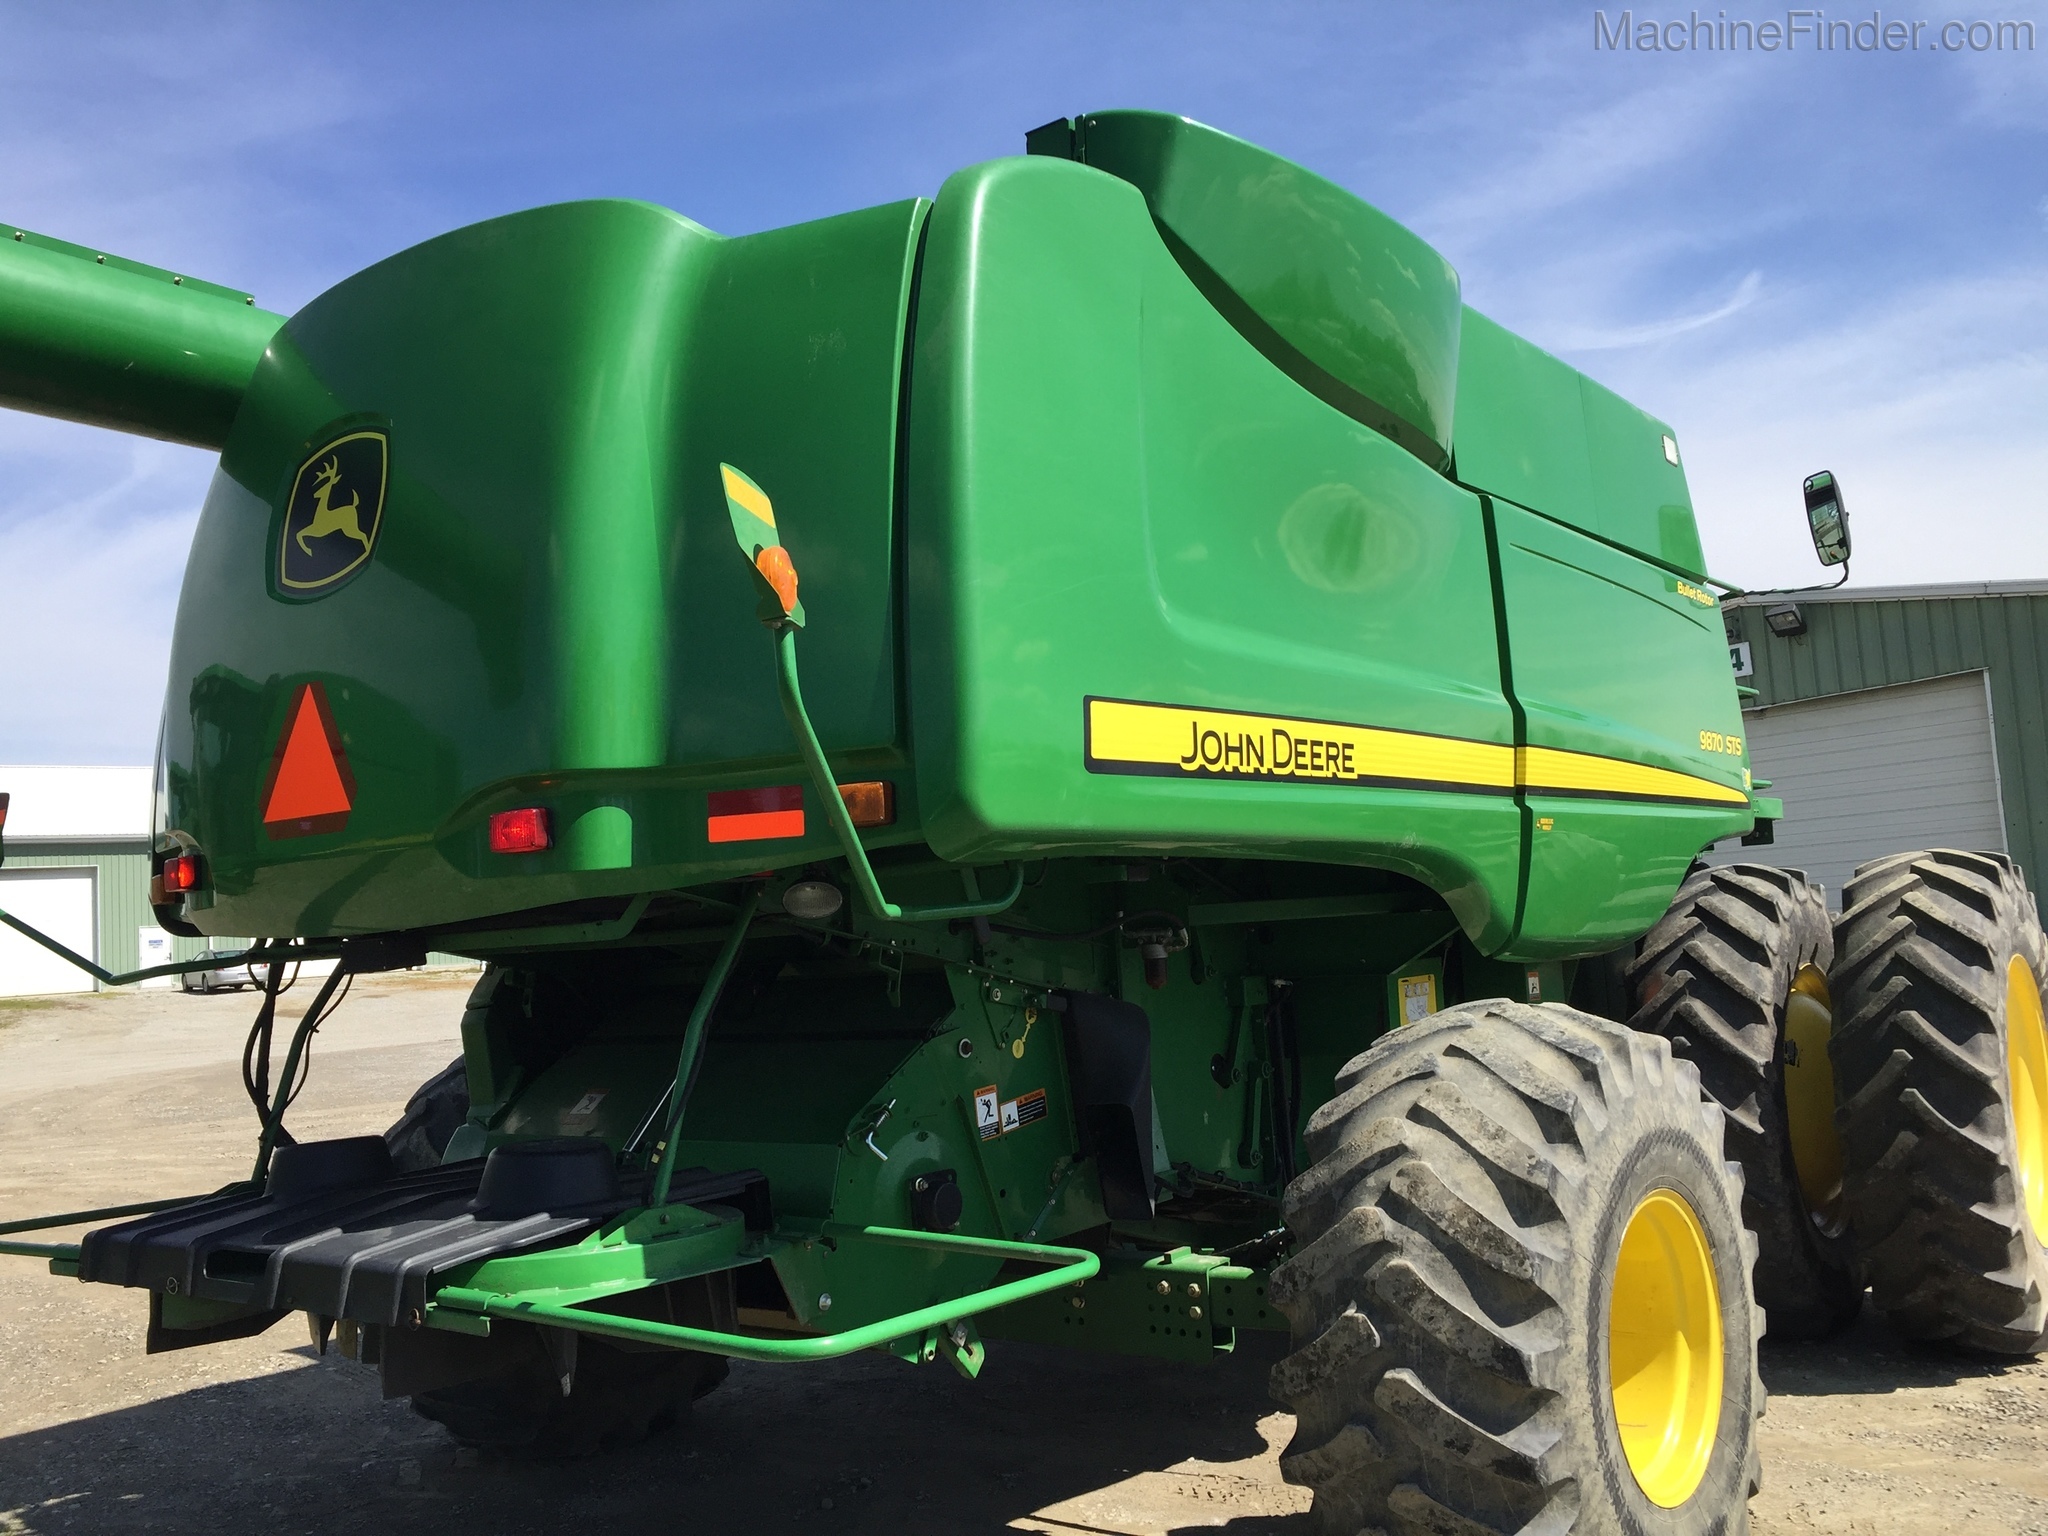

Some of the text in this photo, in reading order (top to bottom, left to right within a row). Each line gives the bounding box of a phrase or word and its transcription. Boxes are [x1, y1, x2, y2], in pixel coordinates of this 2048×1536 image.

[1677, 580, 1697, 600] Bullet
[1180, 721, 1356, 775] JOHN DEERE
[1700, 730, 1742, 756] 9870 STS
